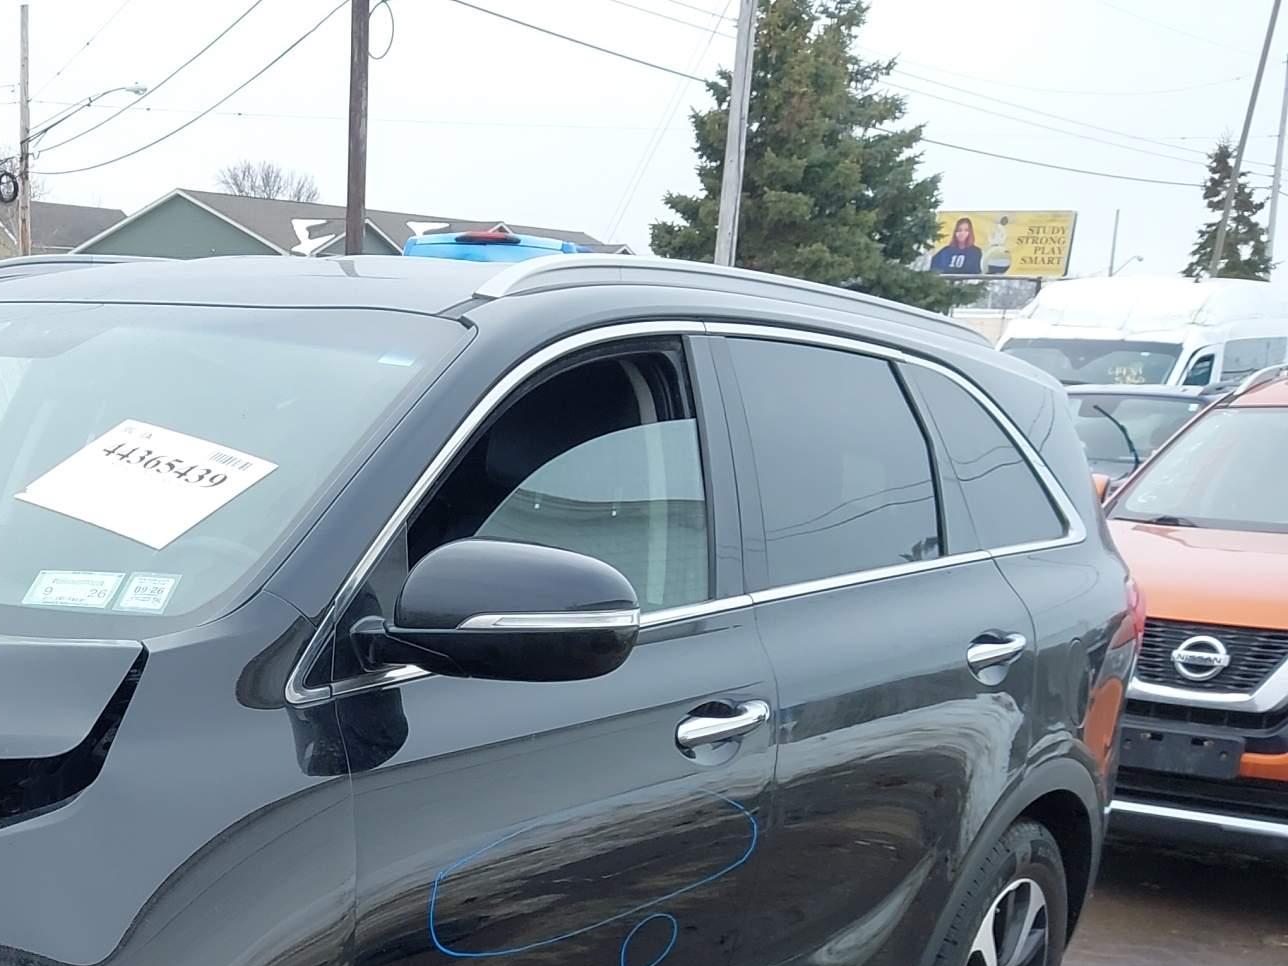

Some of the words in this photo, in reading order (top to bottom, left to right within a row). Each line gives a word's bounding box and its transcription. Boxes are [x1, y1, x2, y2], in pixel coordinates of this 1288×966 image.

[1028, 225, 1066, 235] STUDY
[1016, 236, 1066, 245] STRONG
[1033, 246, 1064, 255] PLAY
[949, 254, 965, 268] 10
[1020, 256, 1063, 265] SMART
[102, 442, 228, 488] 44365439
[88, 588, 108, 599] 26
